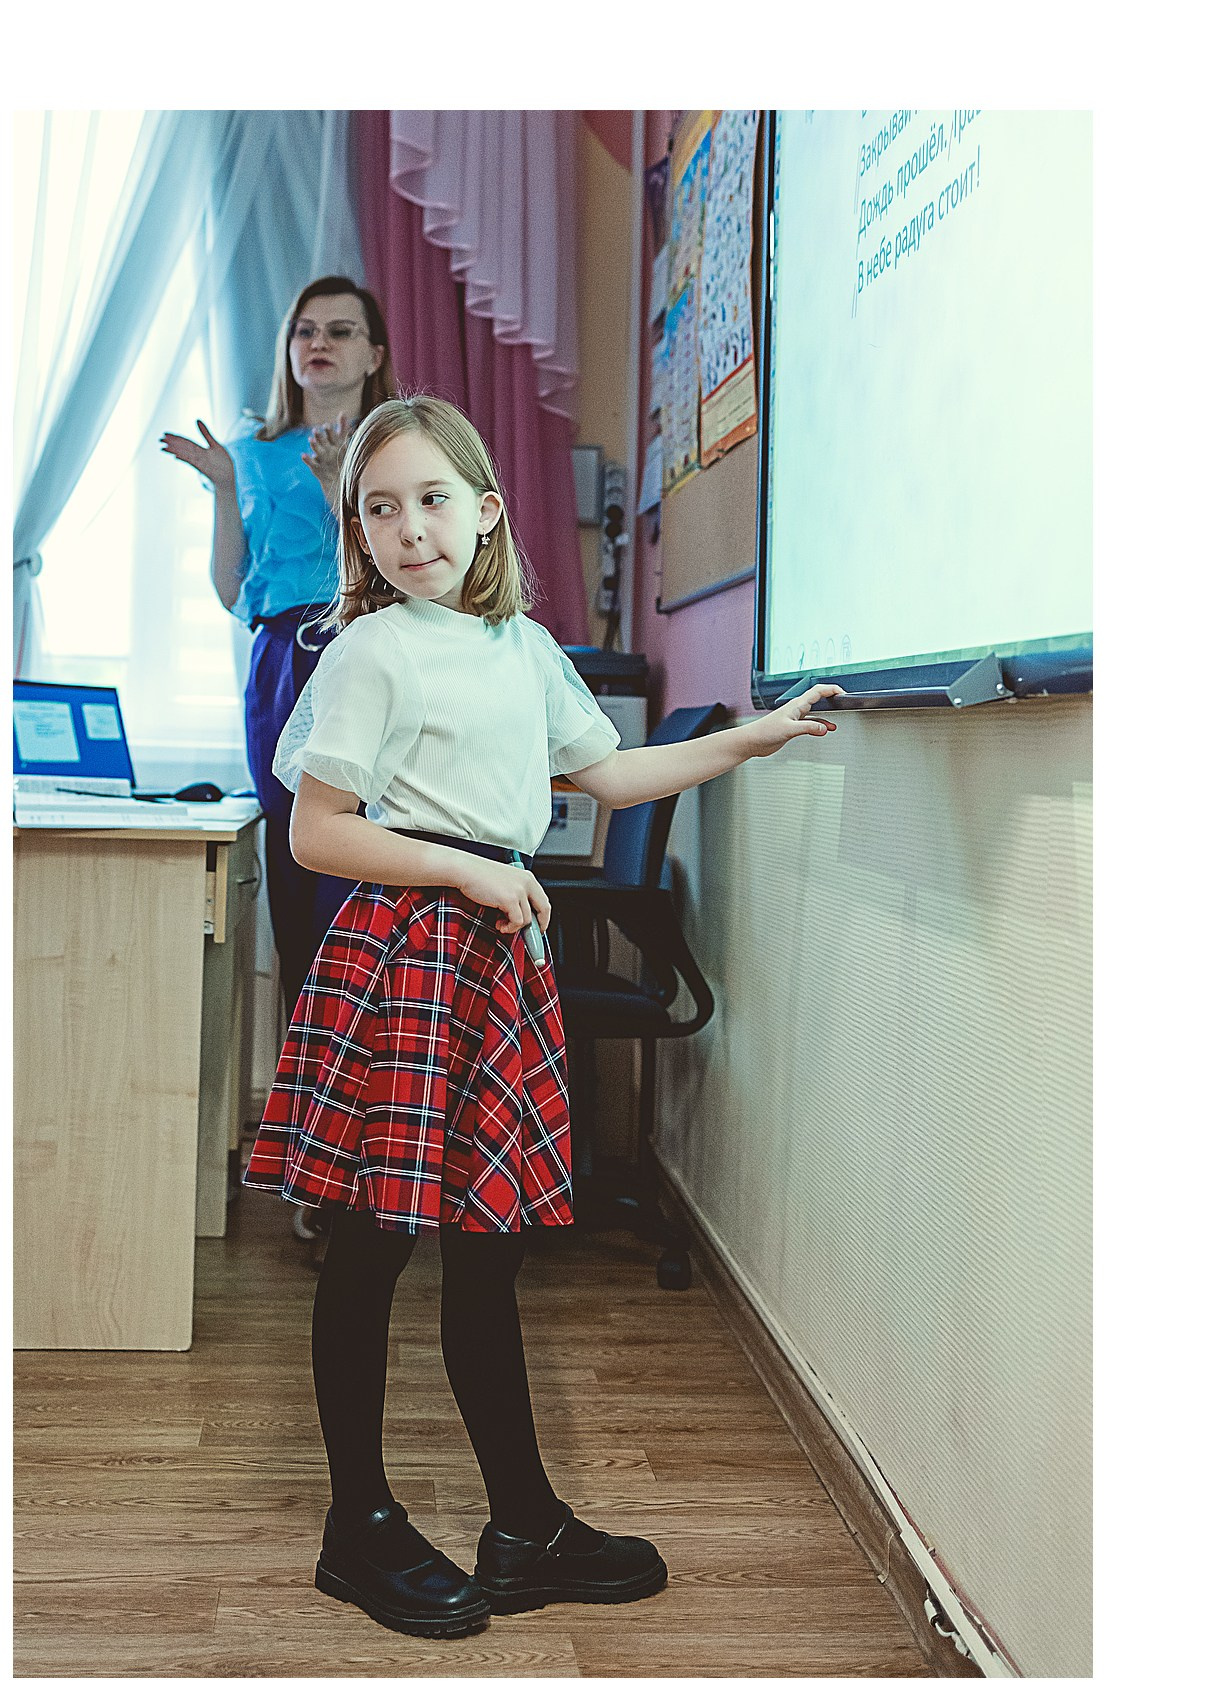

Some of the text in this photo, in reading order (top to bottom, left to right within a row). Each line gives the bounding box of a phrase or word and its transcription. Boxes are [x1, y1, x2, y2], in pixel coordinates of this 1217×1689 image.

[857, 144, 980, 294] В небе радуга стоит!
[858, 180, 893, 244] Дождь
[896, 122, 947, 198] прошёл.
